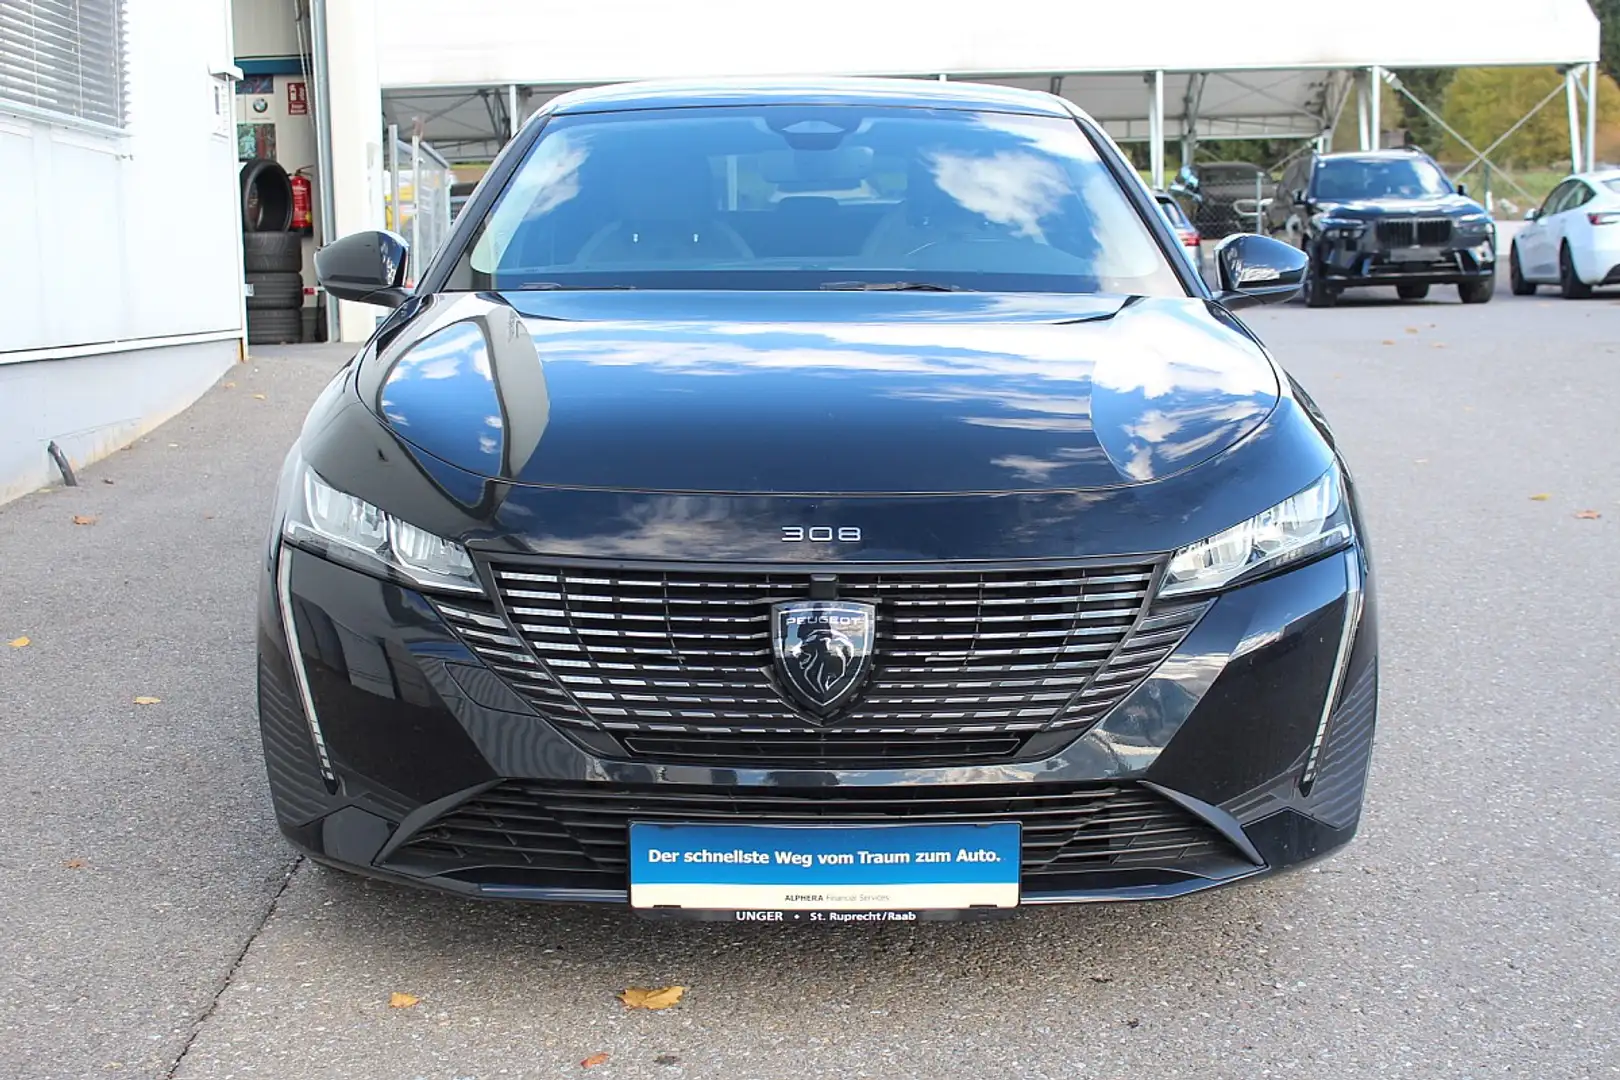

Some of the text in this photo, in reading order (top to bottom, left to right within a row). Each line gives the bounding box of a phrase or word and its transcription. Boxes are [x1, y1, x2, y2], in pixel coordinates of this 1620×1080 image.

[781, 526, 861, 541] 308
[786, 616, 859, 625] PEUGEOT
[648, 849, 1001, 867] Der schnellste Weg vom Traum zum Auto.
[785, 894, 889, 902] ALPHERA Financial Services
[736, 911, 916, 922] UNGER St. Ruprecht/Raab
